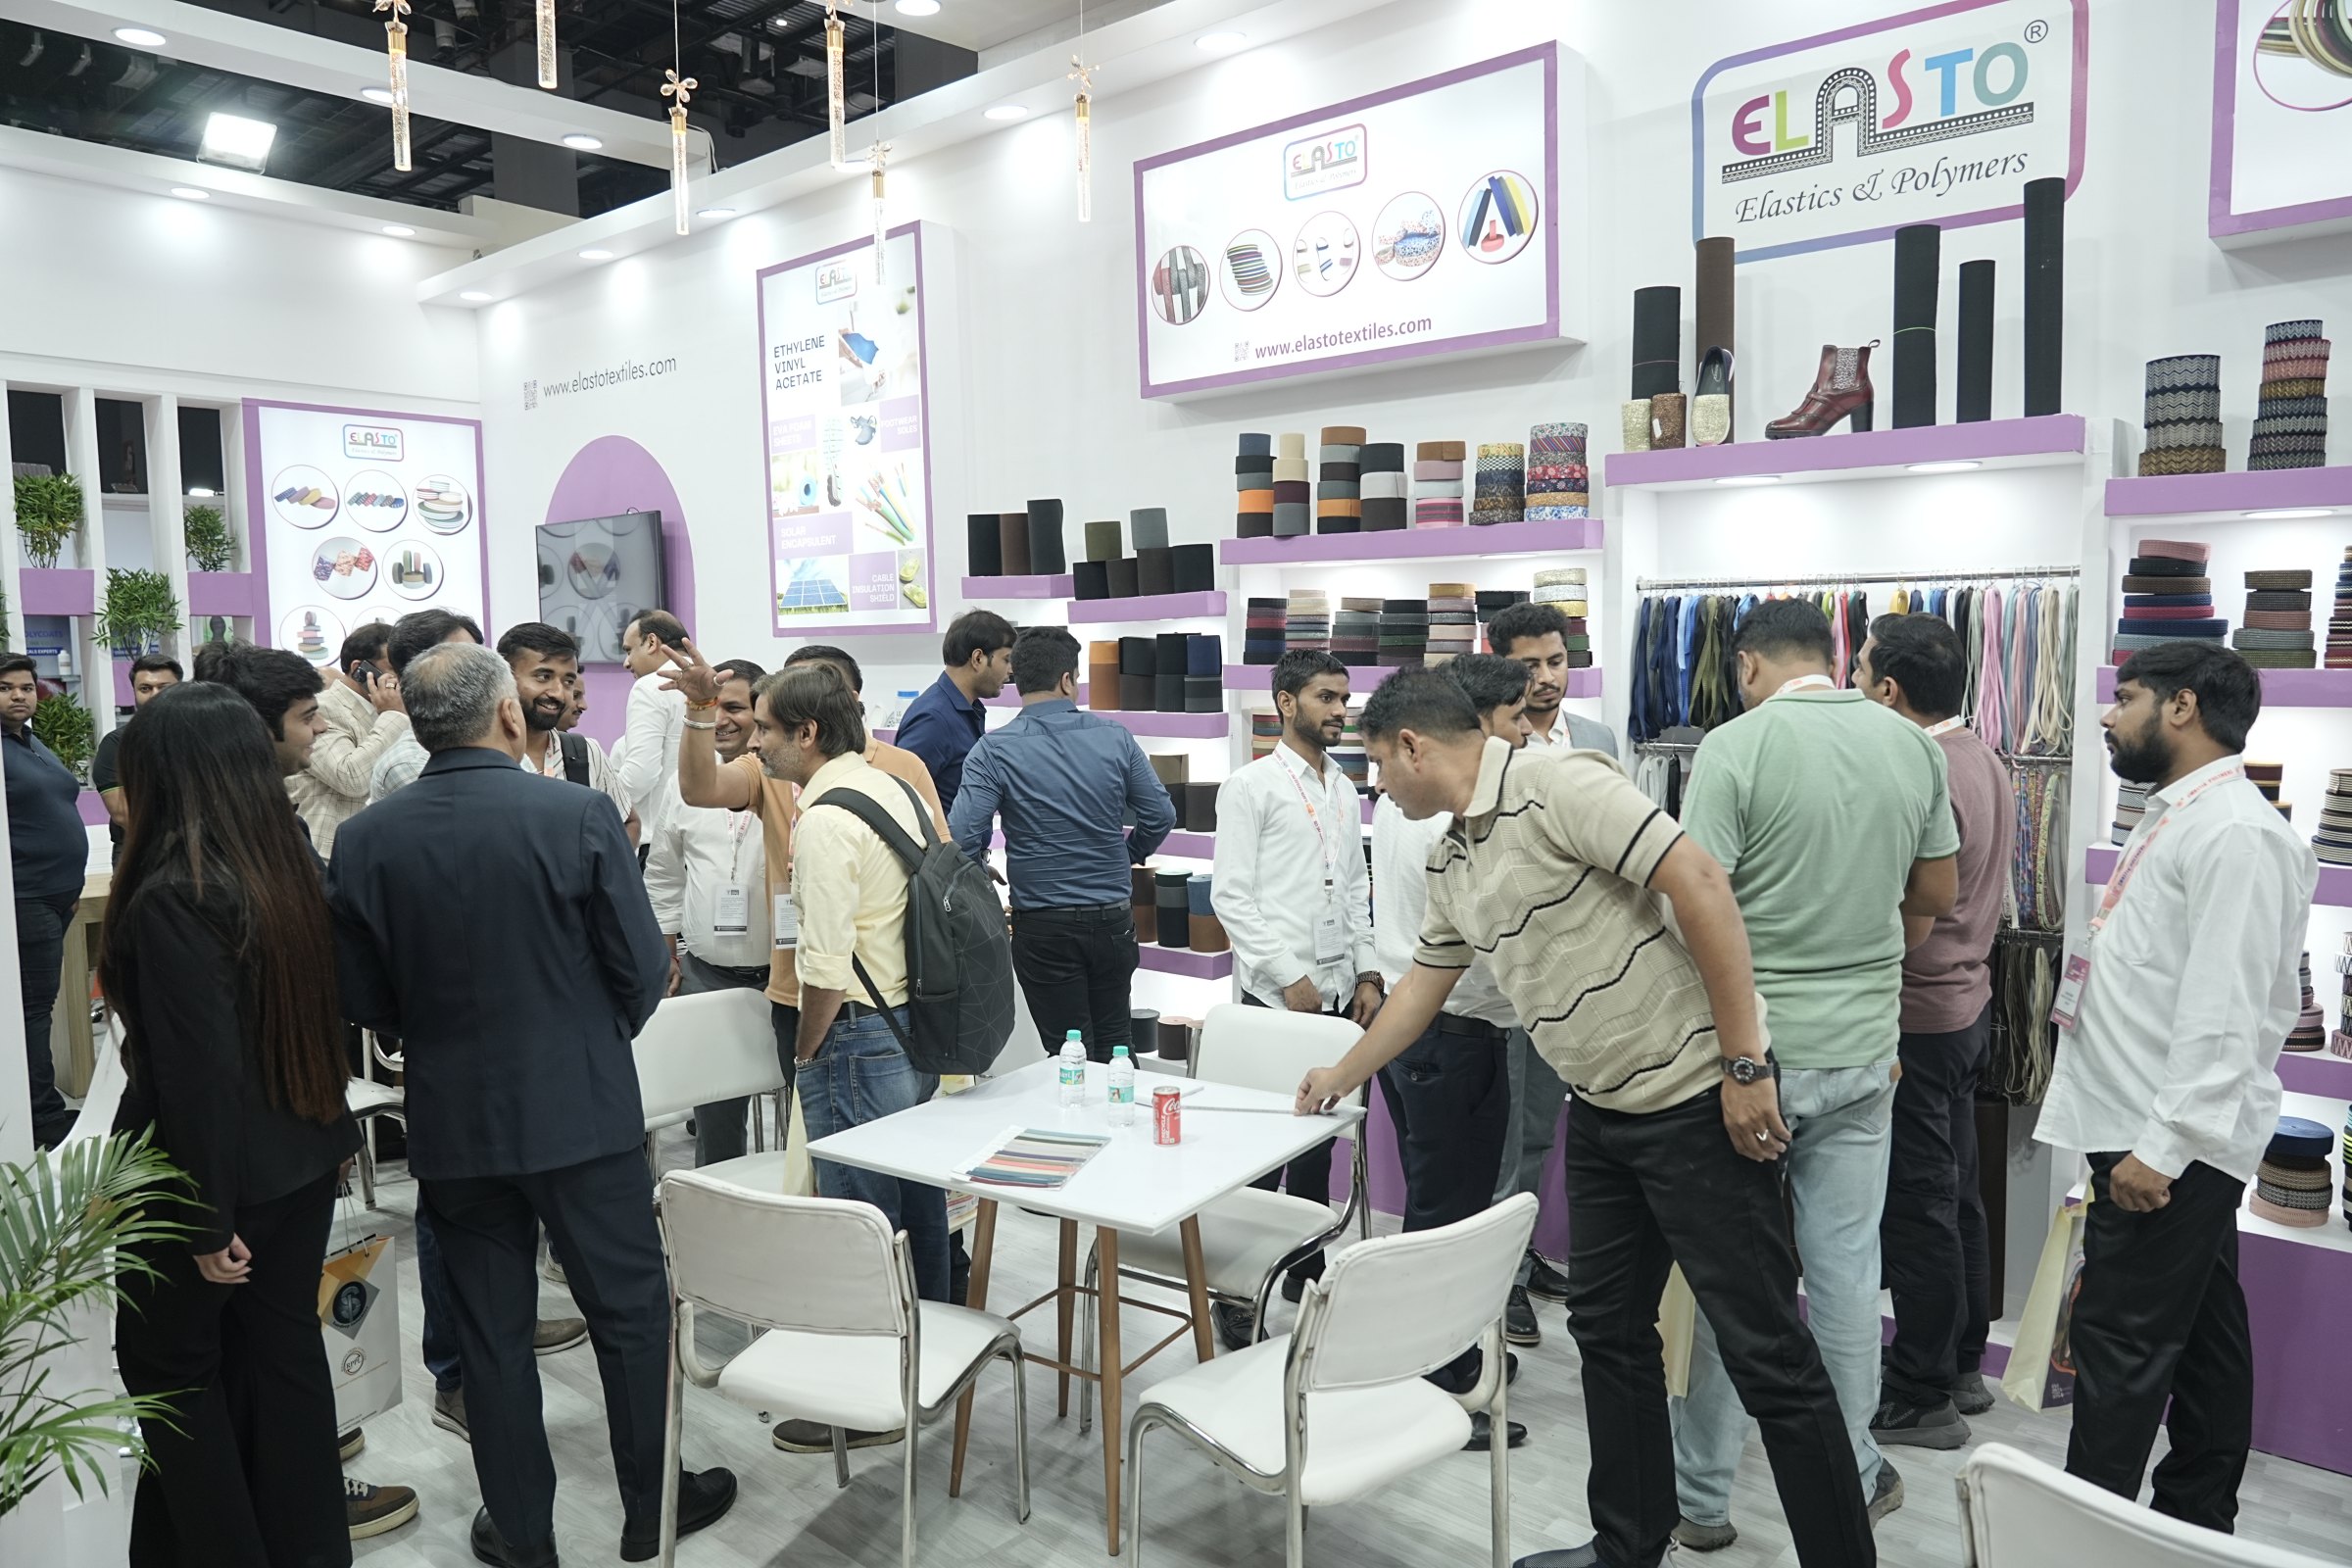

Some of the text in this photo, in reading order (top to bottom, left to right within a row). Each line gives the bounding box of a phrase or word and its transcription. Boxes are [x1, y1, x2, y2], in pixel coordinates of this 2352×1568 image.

[1731, 41, 2030, 163] ELASTO
[1292, 139, 1356, 172] ELASTO
[1735, 152, 2030, 224] Elastics & Polymers
[773, 334, 825, 359] ETHYLENE
[1254, 316, 1433, 360] www.elastotextiles.com
[774, 357, 807, 374] VINYL
[543, 355, 678, 399] www.elastotextiles.com
[775, 369, 823, 391] ACETATE
[881, 415, 918, 429] FOOTWEAR
[897, 423, 918, 435] SOLES
[349, 431, 397, 447] ELASTO
[781, 525, 807, 537] SOLAR
[871, 573, 894, 583] CABLE
[852, 584, 895, 594] INSULATION
[869, 593, 895, 604] SHIELD
